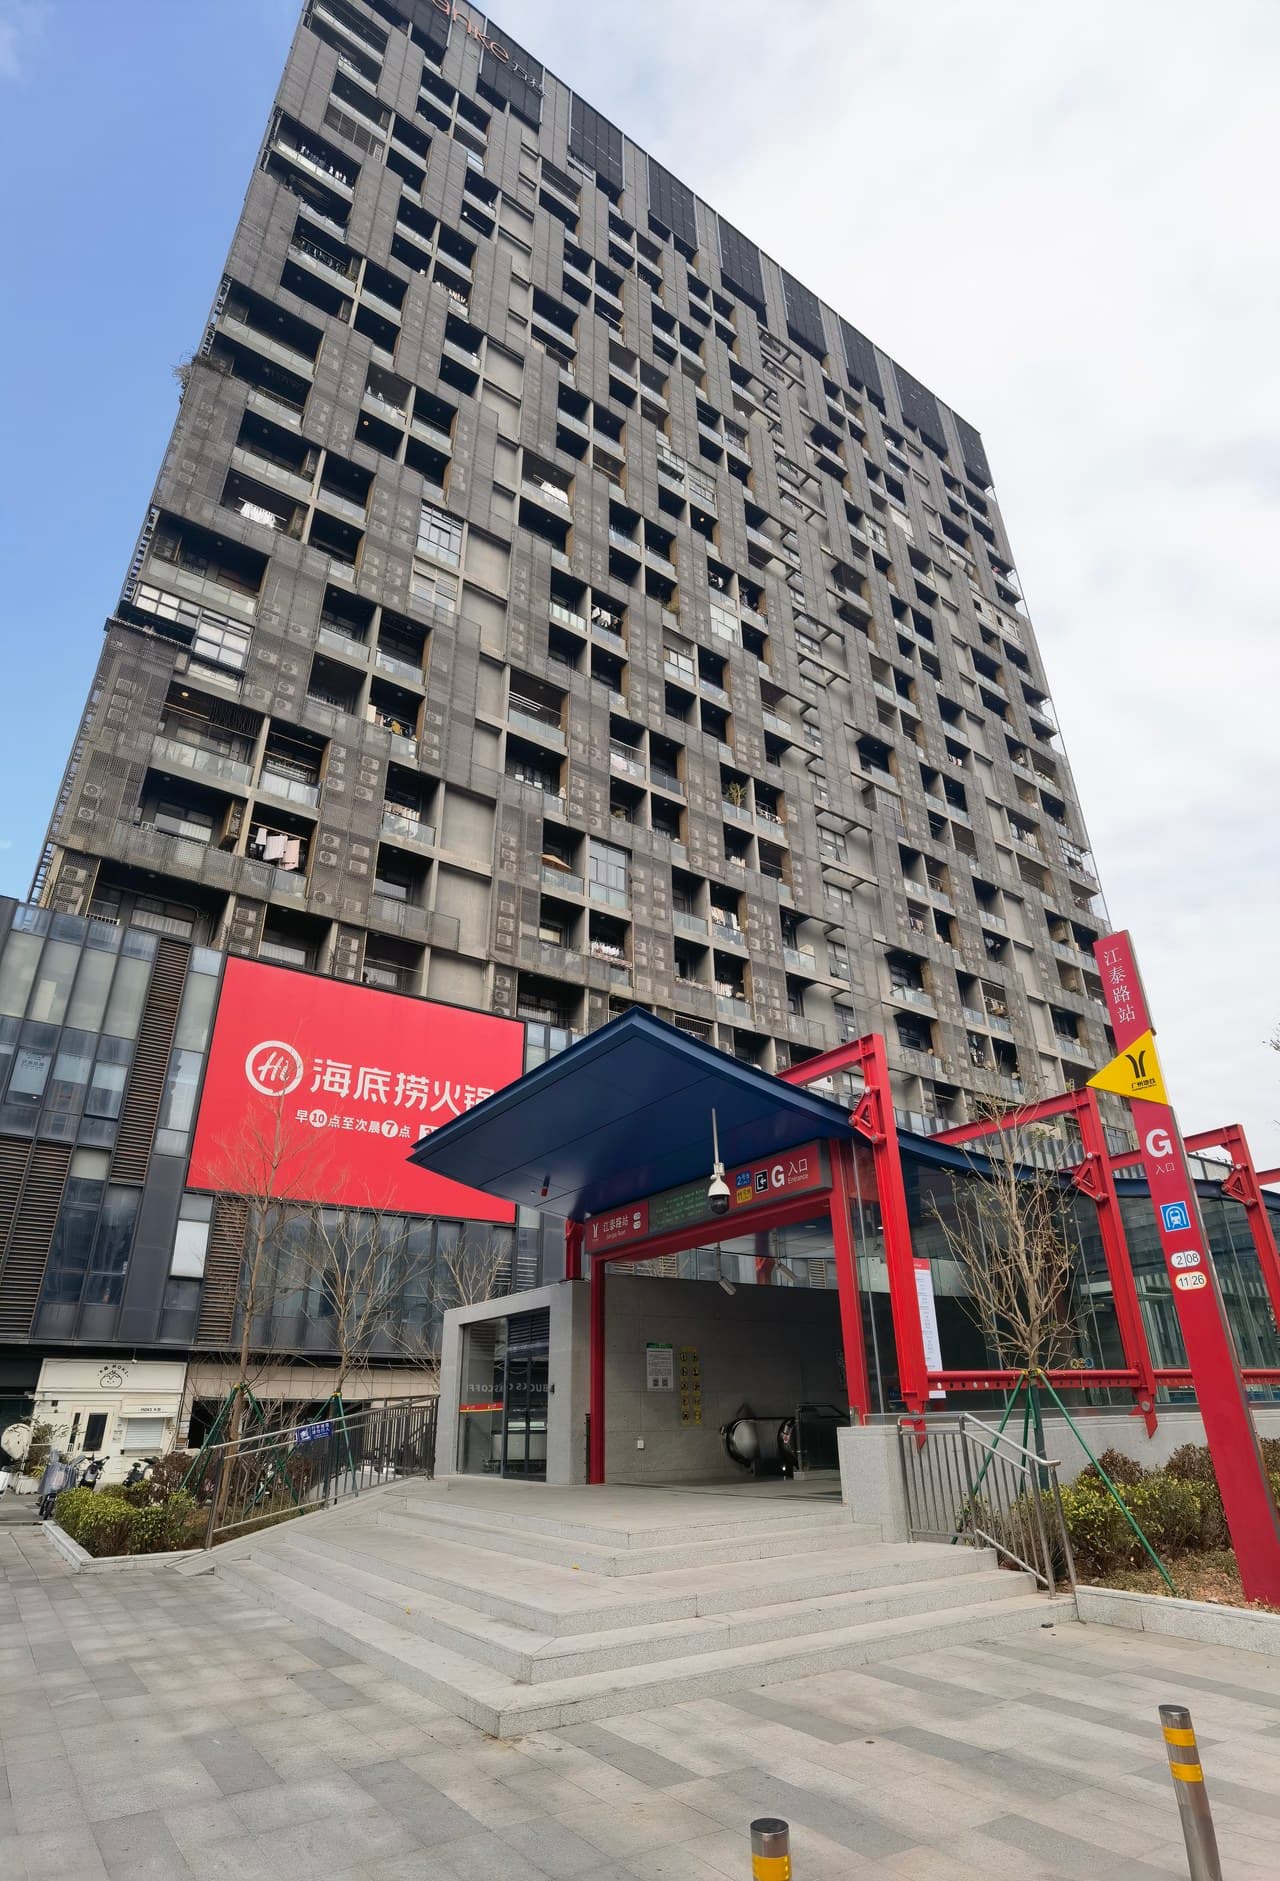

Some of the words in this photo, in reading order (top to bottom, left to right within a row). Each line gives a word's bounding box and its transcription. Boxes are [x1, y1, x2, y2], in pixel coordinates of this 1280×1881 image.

[1104, 947, 1136, 1024] 江泰路站
[257, 1051, 291, 1082] Hi
[1146, 1128, 1173, 1158] G
[771, 1165, 785, 1188] G
[788, 1158, 808, 1177] 入口
[1155, 1162, 1175, 1175] 入口
